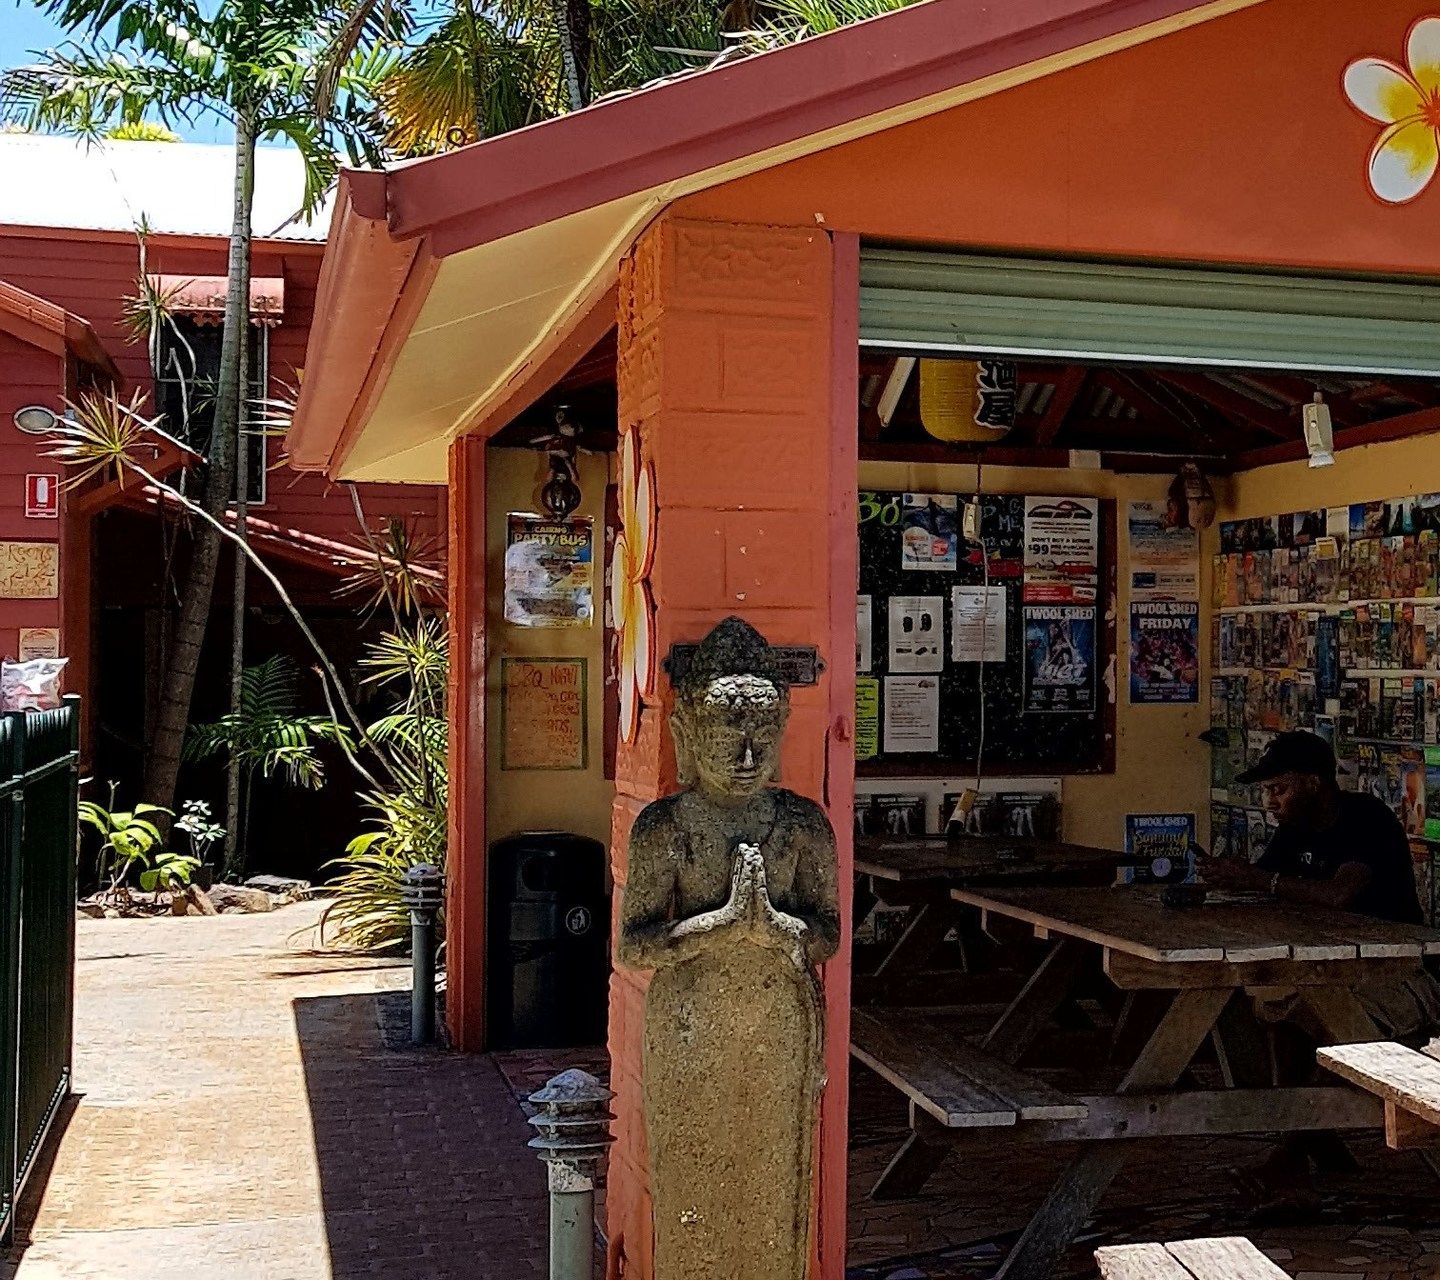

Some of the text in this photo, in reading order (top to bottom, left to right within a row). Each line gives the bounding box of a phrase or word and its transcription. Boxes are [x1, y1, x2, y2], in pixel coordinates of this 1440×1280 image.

[513, 532, 588, 546] PARTY BUS
[1139, 618, 1192, 630] FRIDAY
